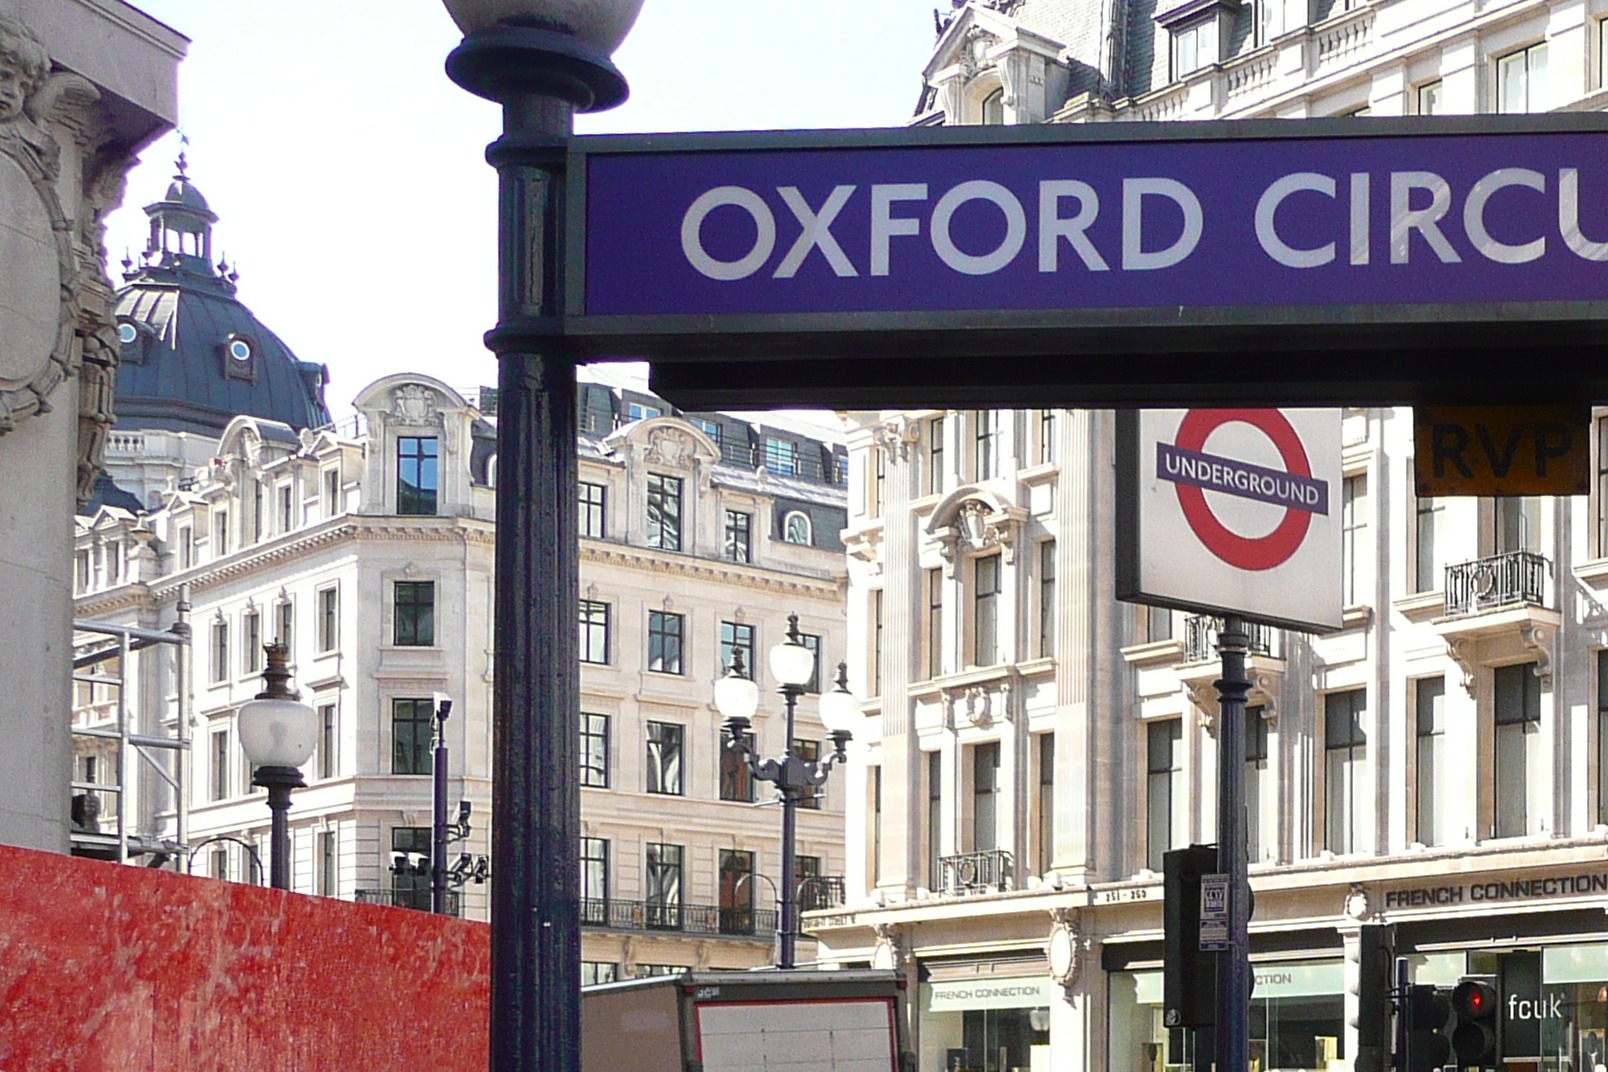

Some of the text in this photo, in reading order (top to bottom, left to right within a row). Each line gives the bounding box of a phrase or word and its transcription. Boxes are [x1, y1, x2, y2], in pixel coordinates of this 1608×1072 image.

[681, 176, 1204, 282] OXFORD
[1429, 422, 1576, 481] RVP
[1164, 452, 1320, 506] UNDERGROUND
[1385, 873, 1608, 907] FRENCH CONNECTION
[935, 986, 1040, 999] FRENCH CONNECTION
[1254, 973, 1292, 985] CTION
[1508, 992, 1562, 1021] fcuk
